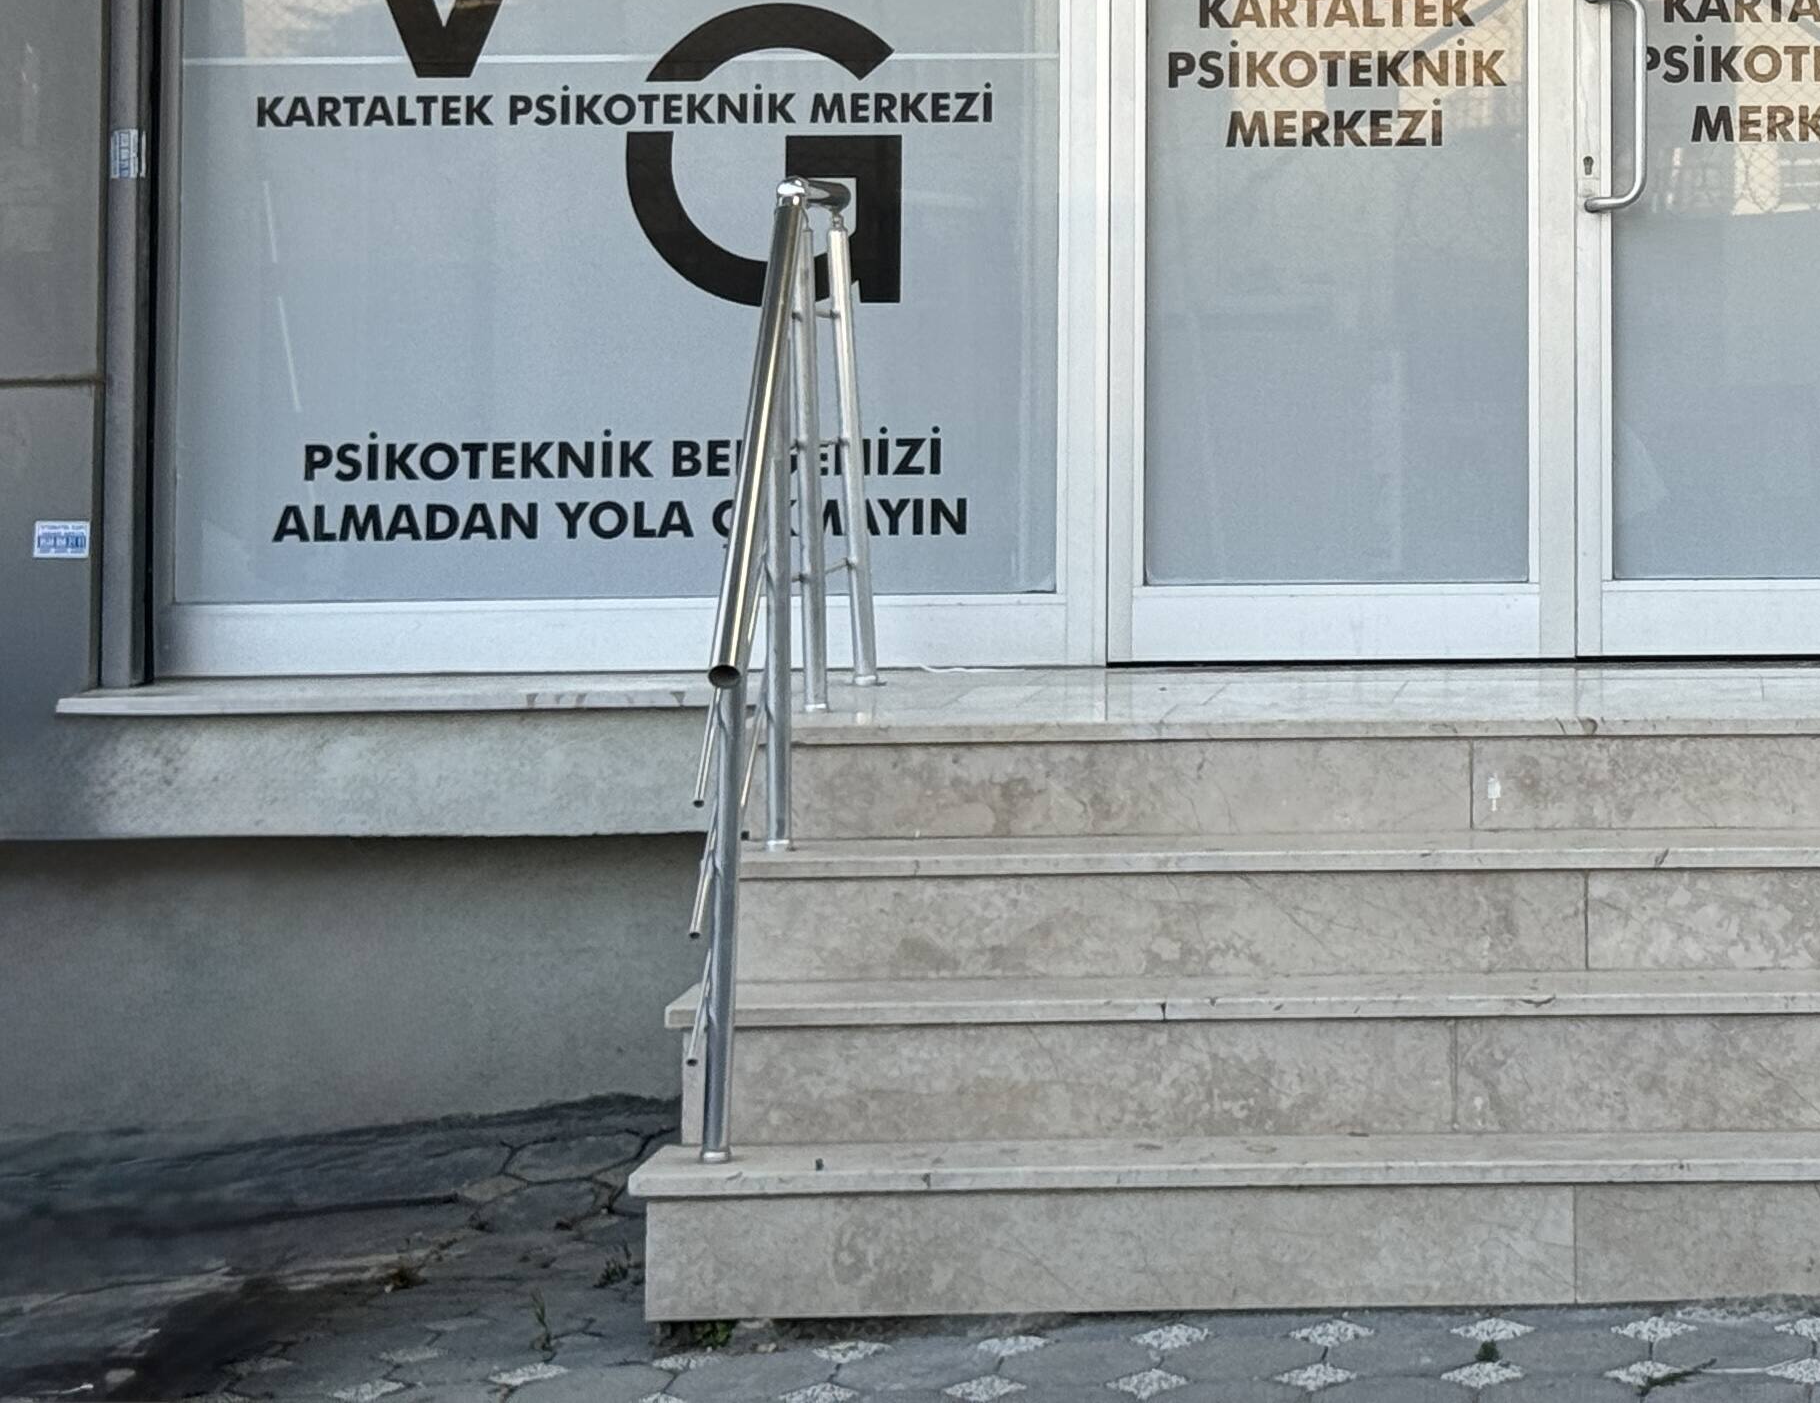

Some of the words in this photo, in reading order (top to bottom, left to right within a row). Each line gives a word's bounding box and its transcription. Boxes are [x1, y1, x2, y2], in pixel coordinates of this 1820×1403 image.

[1167, 39, 1507, 88] PSİKOTEKNİK
[257, 93, 493, 128] KARTALTEK
[509, 84, 796, 126] PSİKOTEKNİK
[810, 83, 994, 124] MERKEZİ
[1225, 97, 1443, 147] MERKEZİ
[625, 2, 902, 308] G
[304, 430, 654, 481] PSİKOTEKNİK
[272, 501, 538, 543] ALMADAN
[555, 500, 695, 540] YOLA
